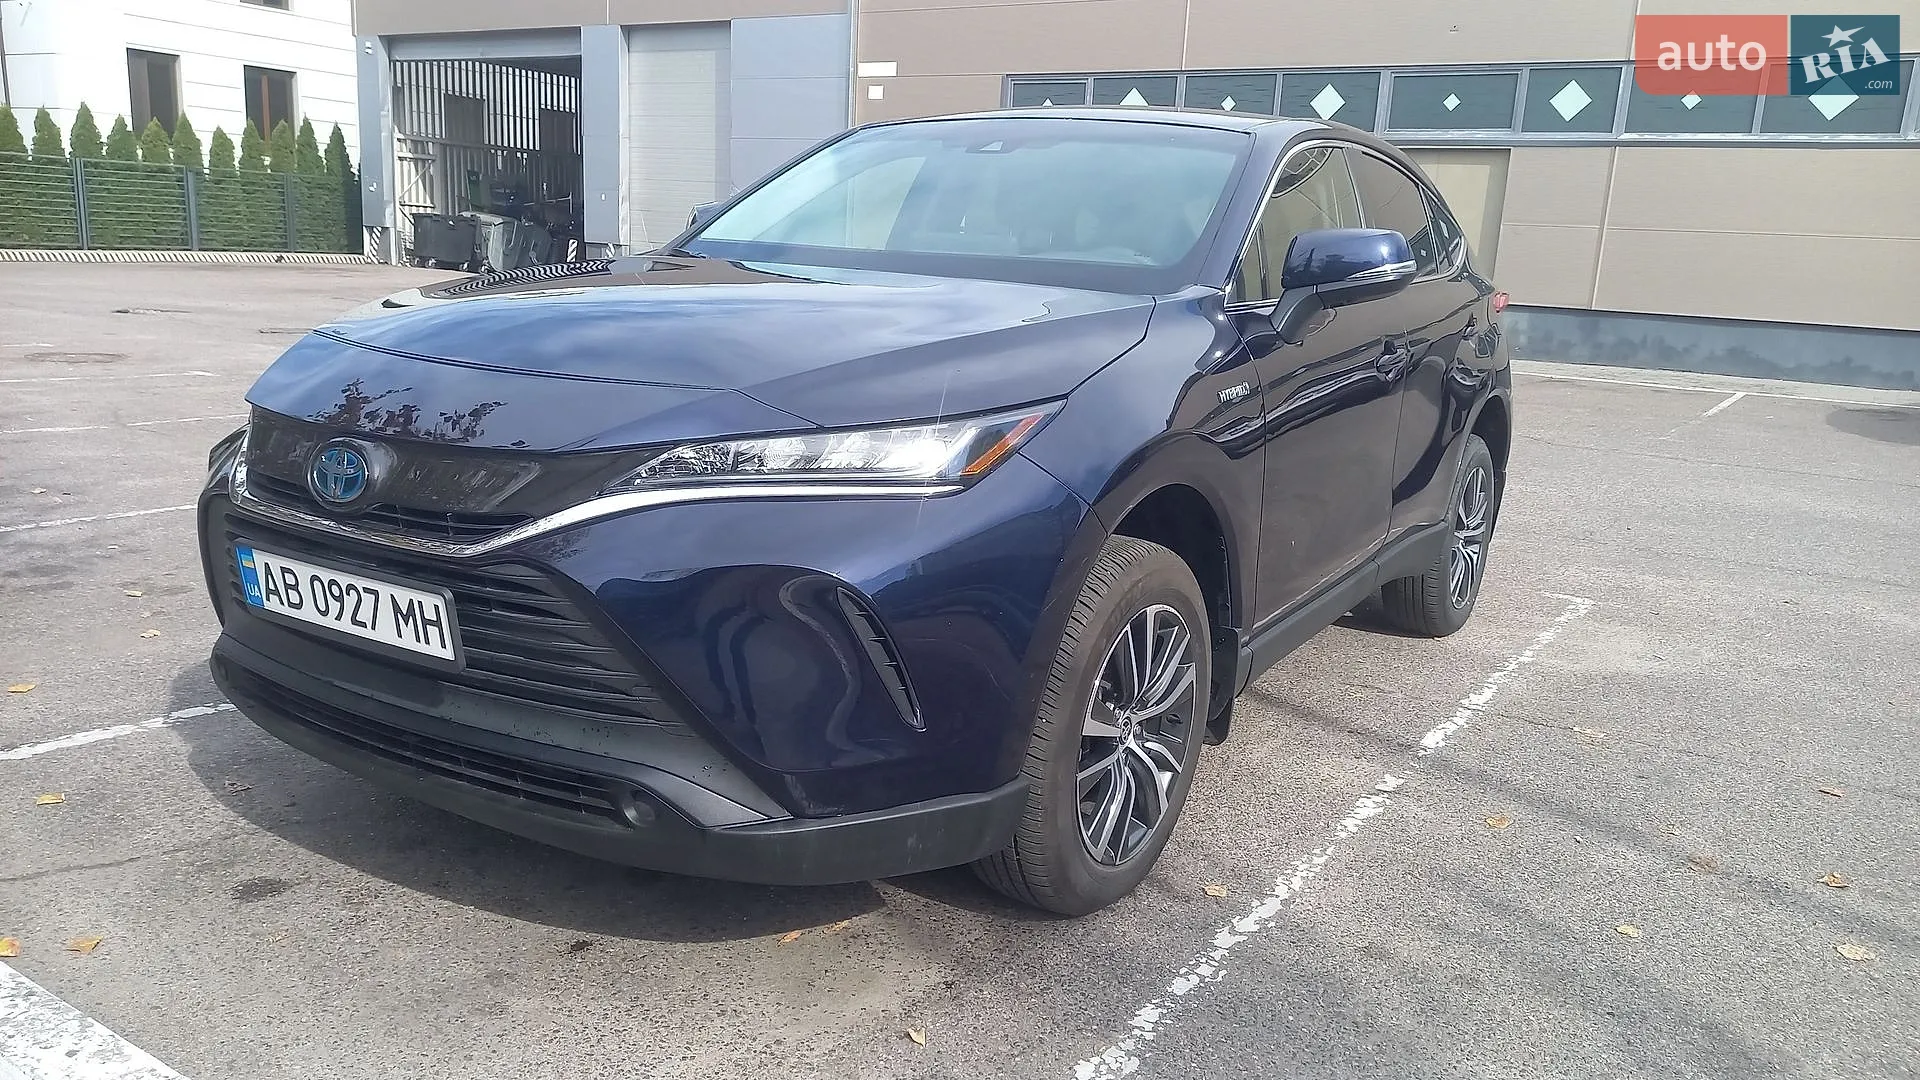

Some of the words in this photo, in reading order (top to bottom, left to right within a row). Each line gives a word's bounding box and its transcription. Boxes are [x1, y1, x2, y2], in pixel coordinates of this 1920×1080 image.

[247, 584, 261, 598] UA
[264, 561, 303, 610] AB
[309, 574, 379, 631] 0927
[391, 593, 446, 649] MH
